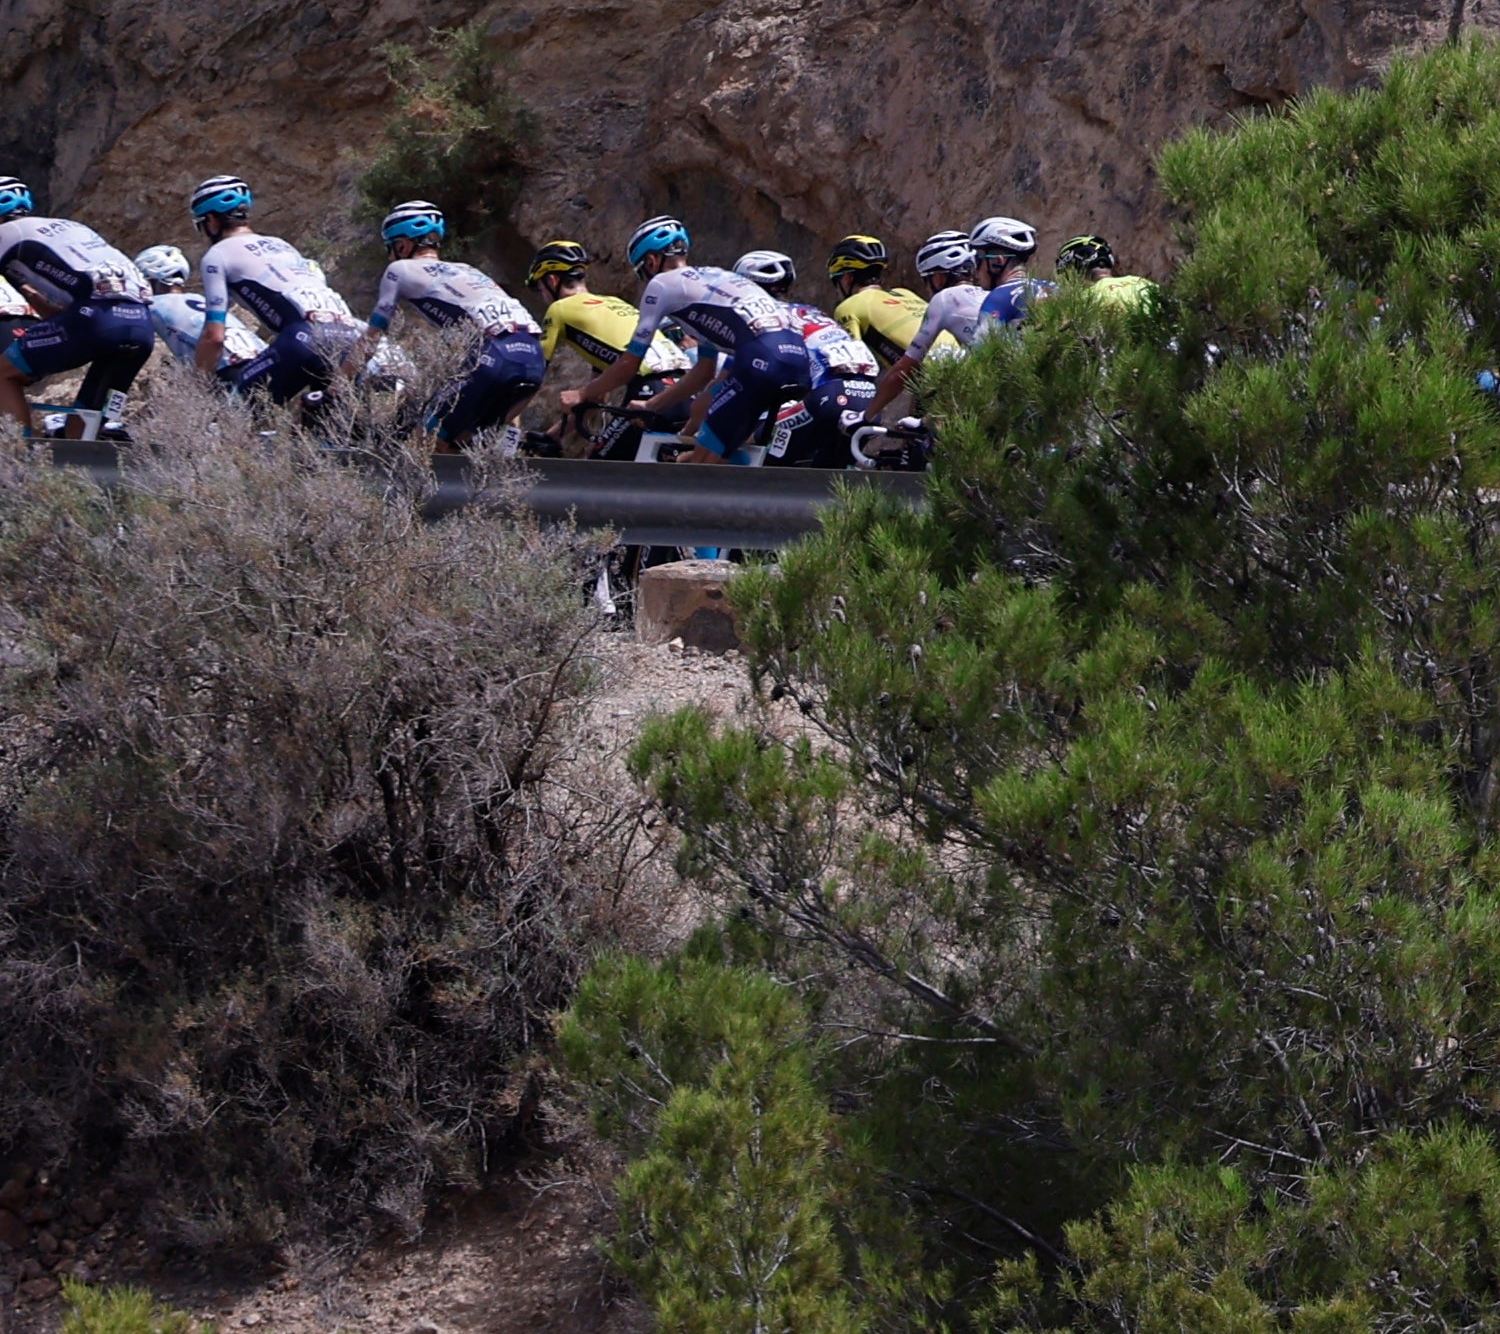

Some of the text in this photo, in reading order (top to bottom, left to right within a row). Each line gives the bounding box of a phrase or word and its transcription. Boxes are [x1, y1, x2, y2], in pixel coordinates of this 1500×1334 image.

[240, 285, 283, 327] BAHRAIN
[477, 300, 513, 324] 134
[688, 309, 737, 345] BAHRAIN
[109, 393, 125, 414] 133
[772, 429, 788, 451] 136
